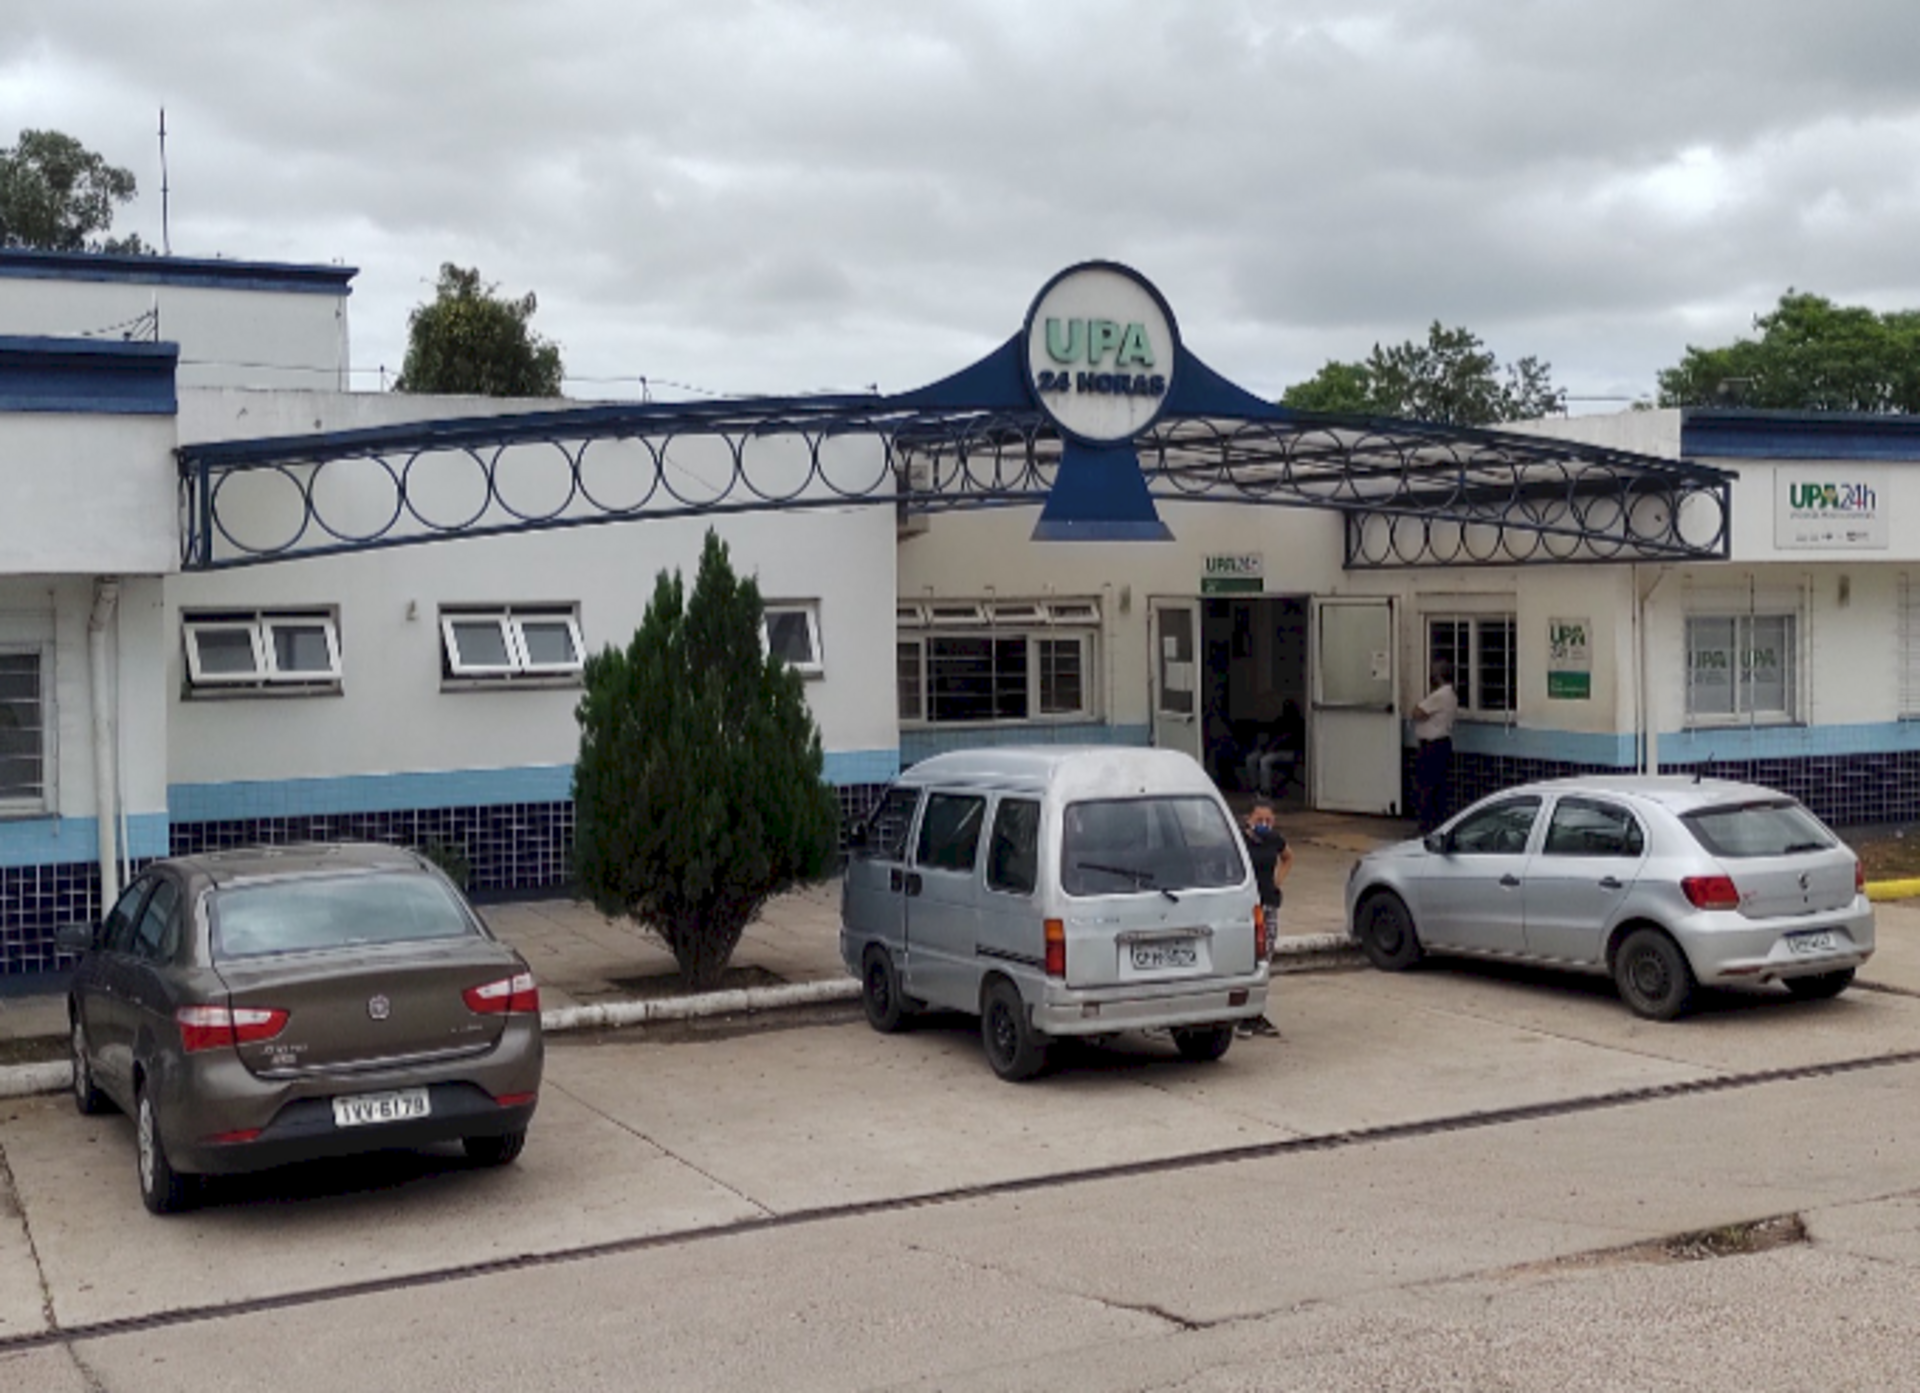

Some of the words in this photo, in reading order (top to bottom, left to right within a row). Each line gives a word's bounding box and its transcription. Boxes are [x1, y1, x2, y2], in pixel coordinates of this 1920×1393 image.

[1045, 317, 1155, 368] UPA
[1037, 370, 1071, 393] 24
[1076, 372, 1165, 397] HORAS
